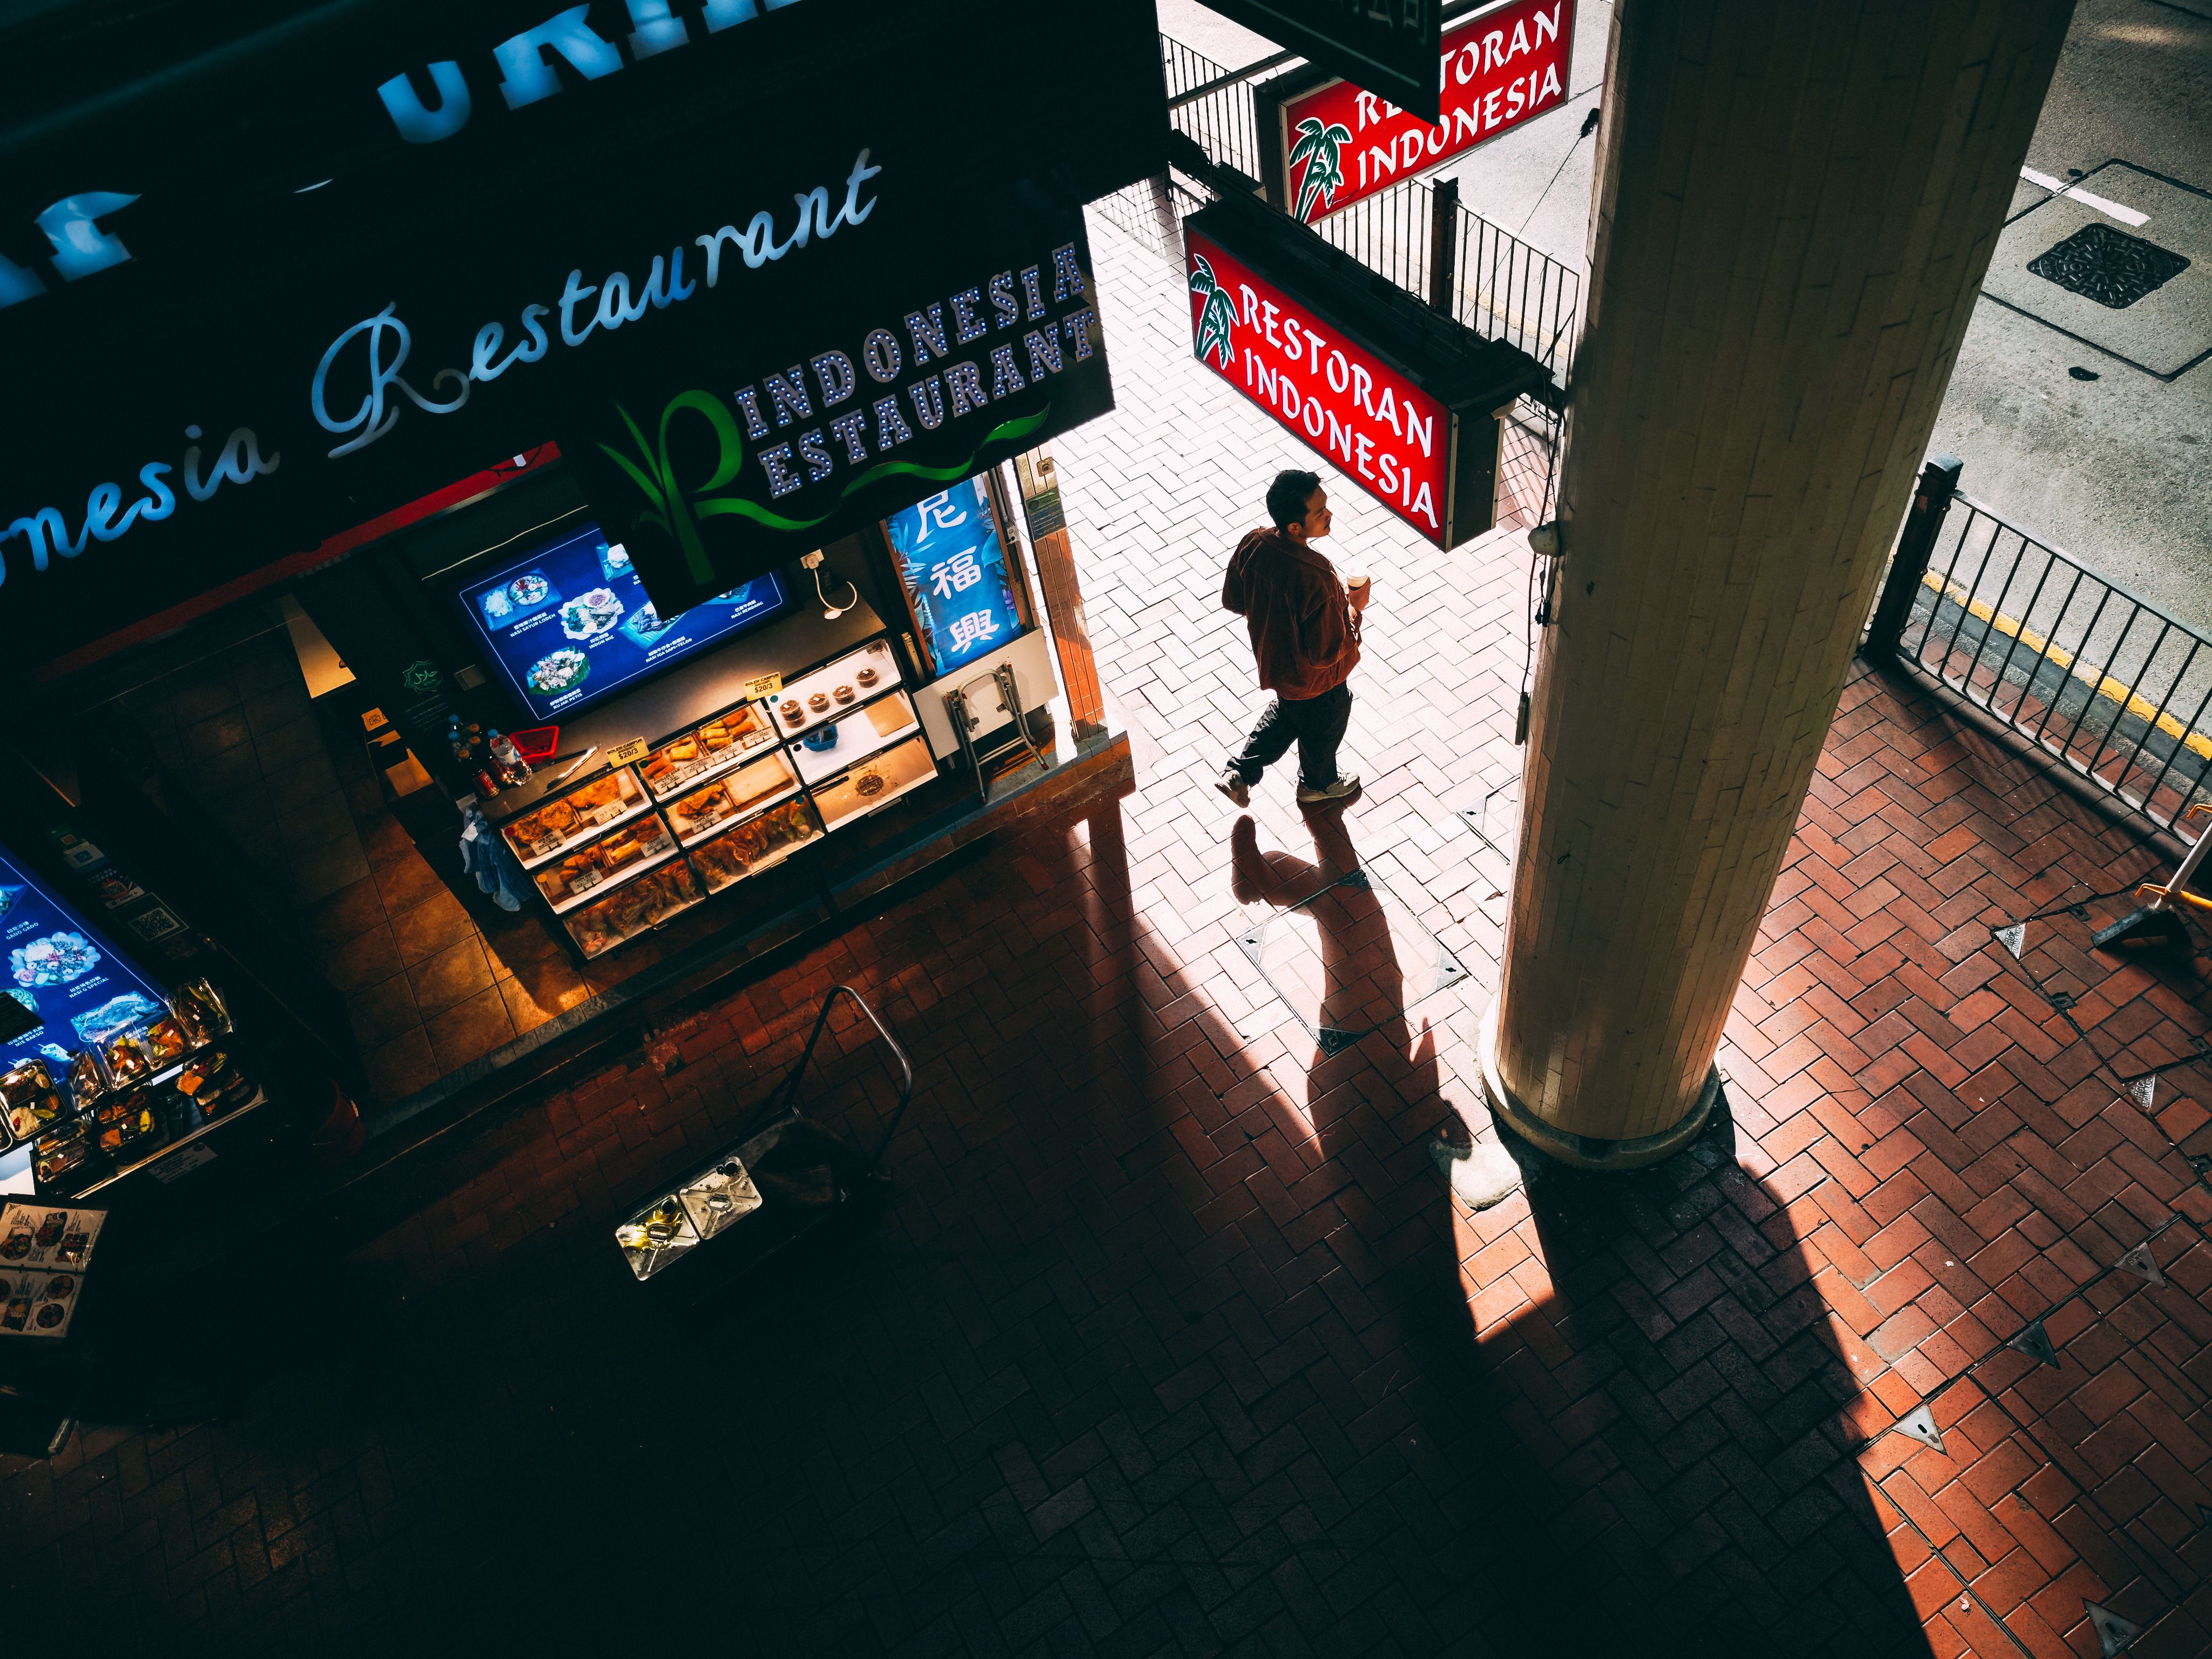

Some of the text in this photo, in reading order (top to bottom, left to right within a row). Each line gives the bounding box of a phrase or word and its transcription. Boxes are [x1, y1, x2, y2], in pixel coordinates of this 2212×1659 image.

[1354, 1, 1561, 132] RTORAN
[1357, 63, 1561, 190] INDONESIA
[311, 148, 881, 459] Restaurant
[734, 242, 1087, 441] INDONESIA
[1239, 284, 1433, 458] RESTORAN
[1244, 348, 1439, 528] INDONESIA
[742, 602, 763, 613] RENDANG
[510, 613, 556, 637] NASI SAYUR LODEH
[589, 639, 605, 649] INDON
[755, 683, 773, 693] $20/3
[618, 747, 638, 760] $20/3
[6, 923, 38, 939] GADO GADO
[2011, 926, 2023, 953] BROADBAND
[87, 977, 109, 989] SPECIAL
[25, 1031, 44, 1041] BAKSO
[2135, 1082, 2144, 1098] HGC
[2142, 1077, 2153, 1108] BROADBAND
